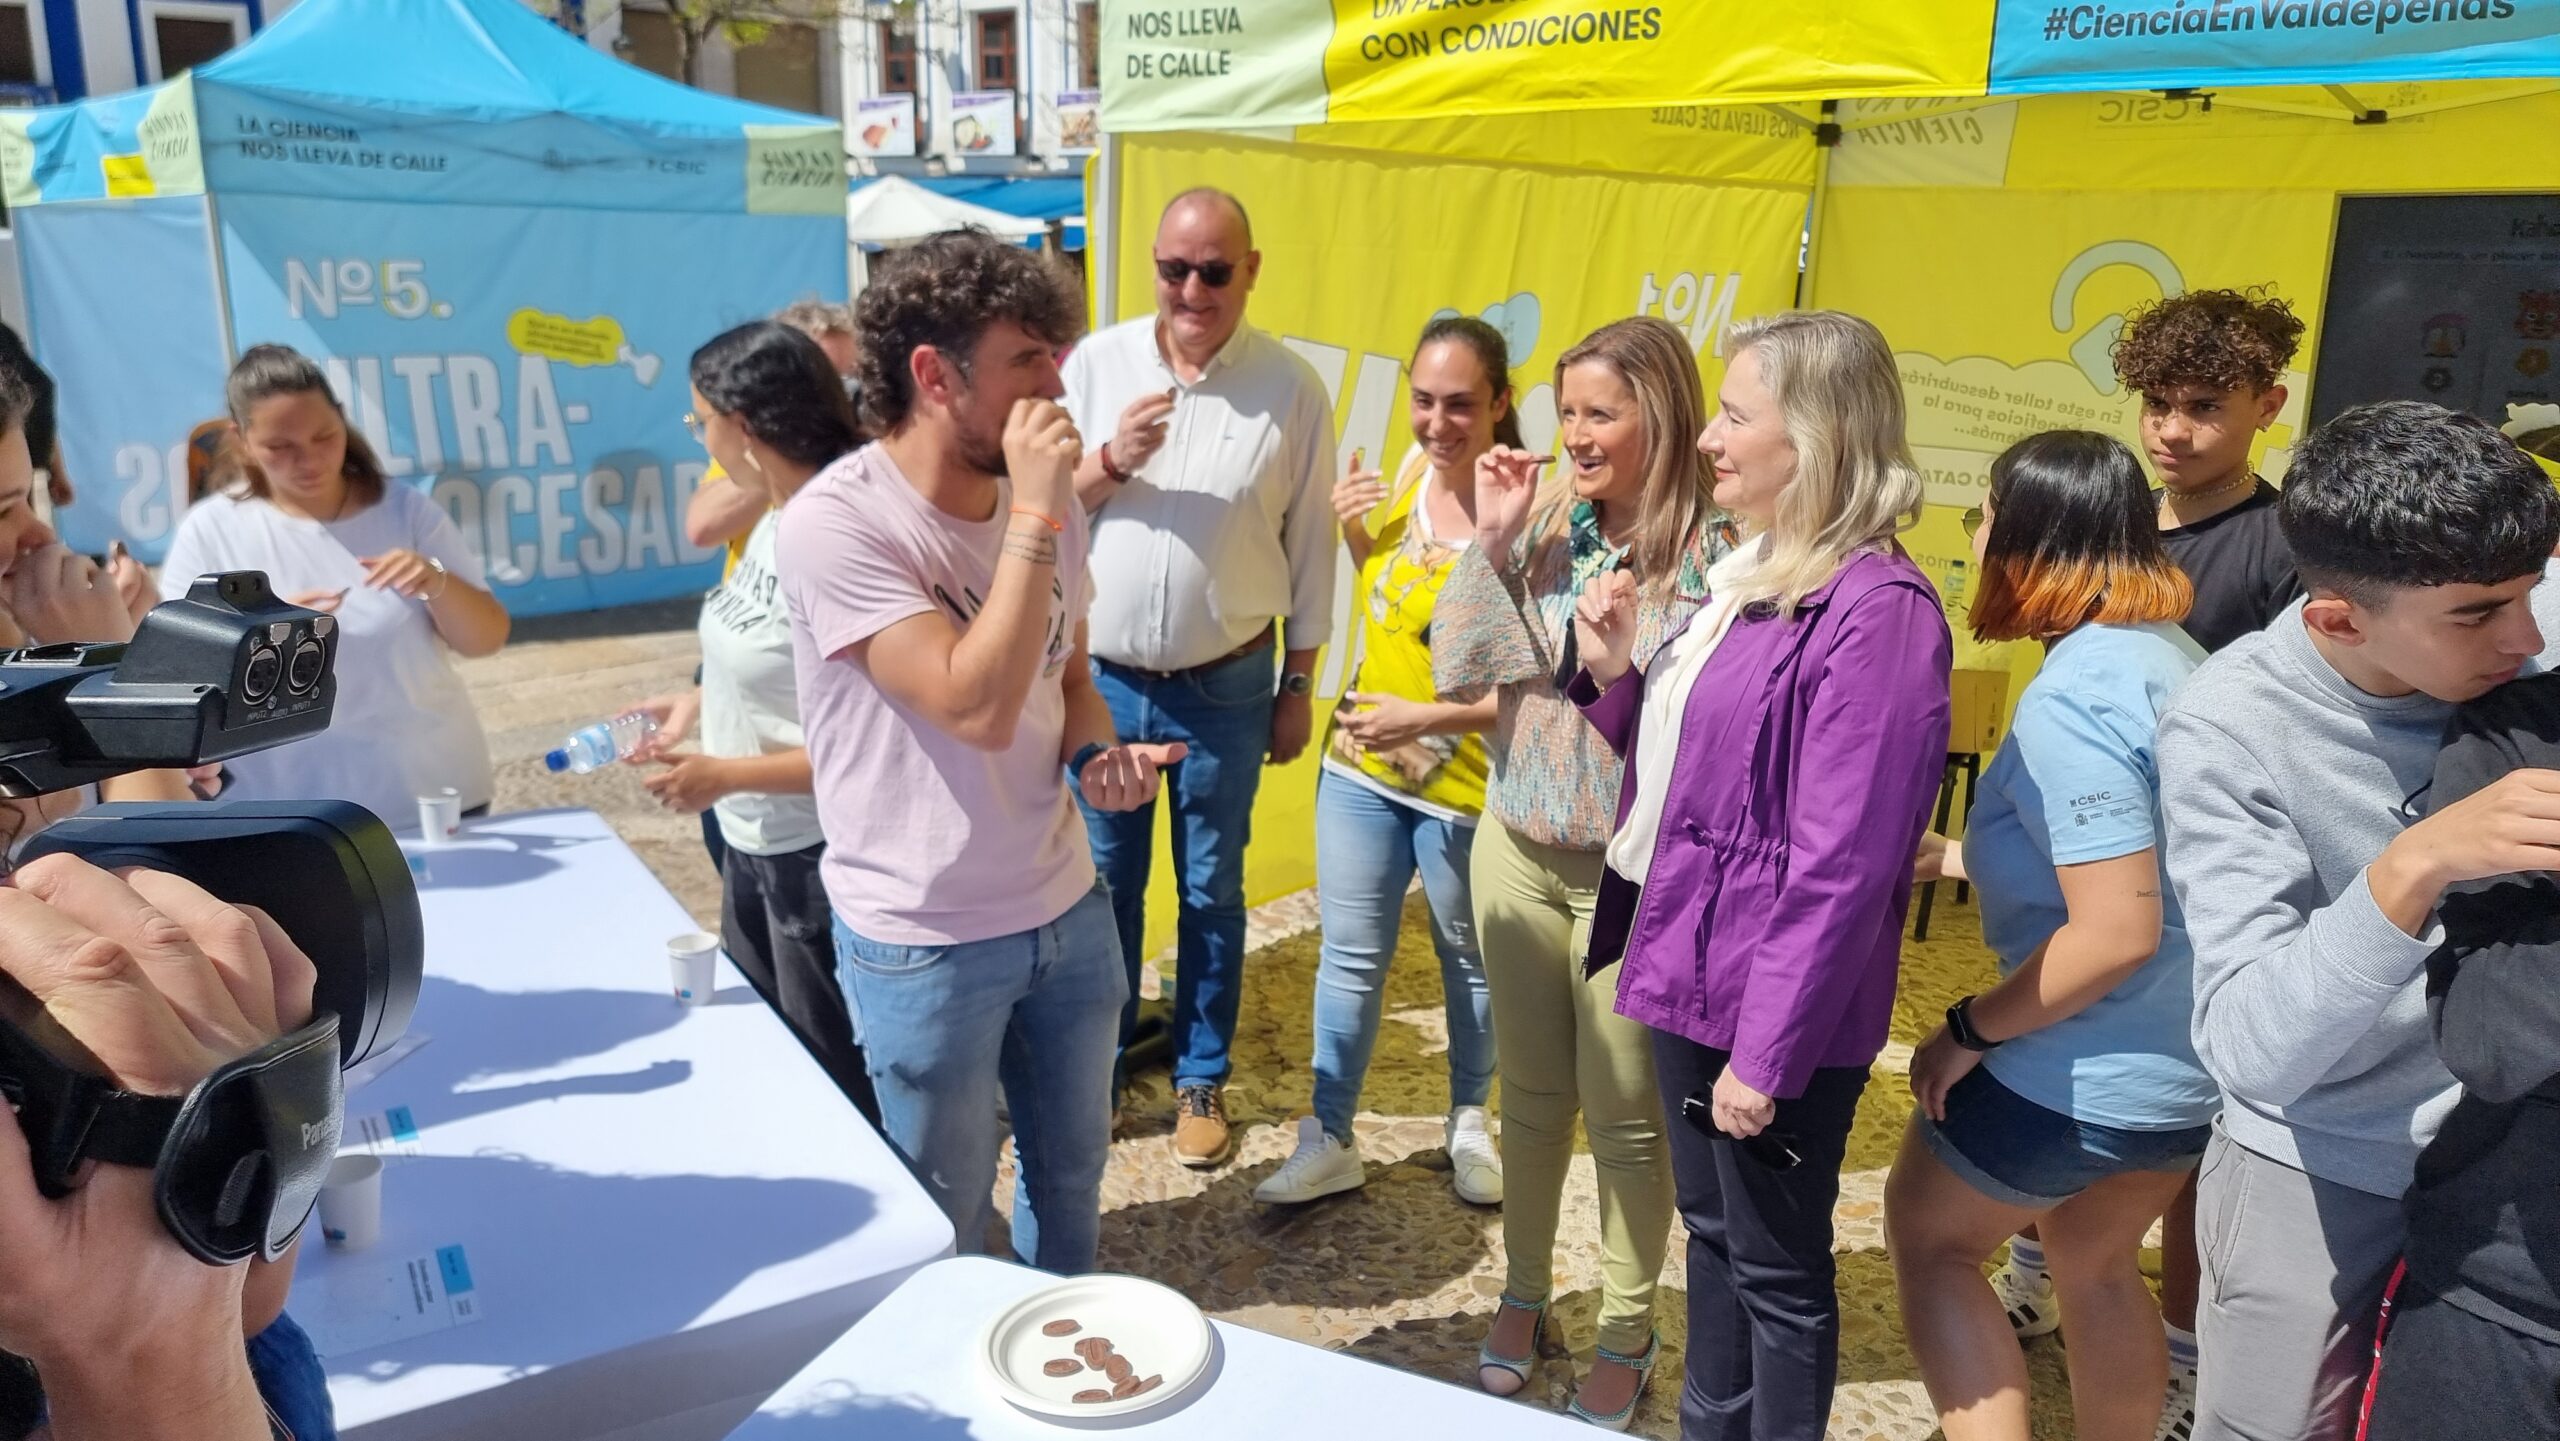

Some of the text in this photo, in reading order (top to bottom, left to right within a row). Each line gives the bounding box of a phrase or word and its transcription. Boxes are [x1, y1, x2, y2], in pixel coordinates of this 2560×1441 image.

[1128, 7, 1242, 38] NOS LLEVA
[1361, 7, 1662, 61] CON CONDICIONES
[1127, 50, 1232, 78] DE CALLE
[238, 115, 361, 143] LA CIENCIA
[240, 140, 448, 172] NOS LLEVA DE CALLE
[2077, 790, 2112, 806] CSIC
